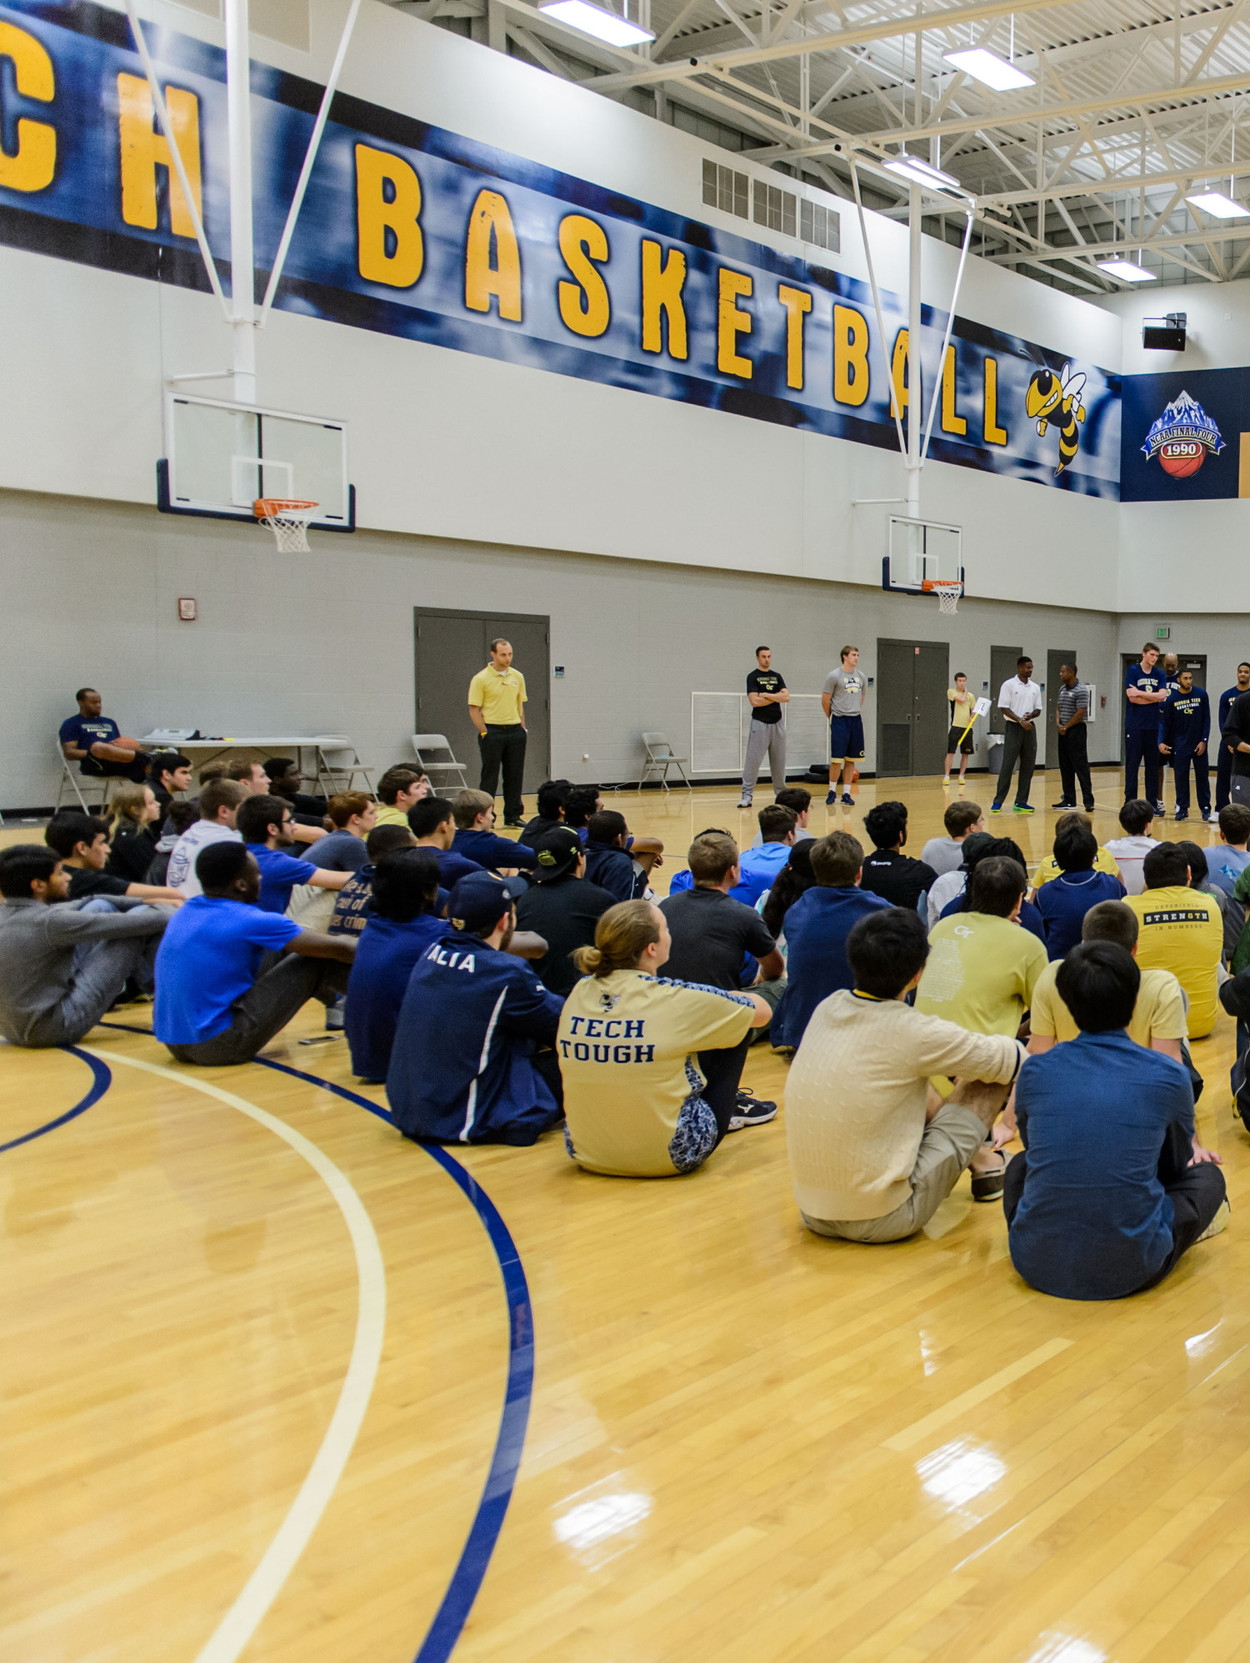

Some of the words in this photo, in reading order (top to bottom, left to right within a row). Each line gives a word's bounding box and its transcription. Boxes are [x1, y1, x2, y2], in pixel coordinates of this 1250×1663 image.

[1150, 429, 1170, 445] NCAA
[1172, 427, 1195, 437] FINAL
[1197, 429, 1217, 444] FOUR
[1167, 444, 1196, 456] 1990
[1146, 913, 1207, 922] STRENGTH
[570, 1016, 645, 1038] TECH
[560, 1040, 655, 1063] TOUGH
